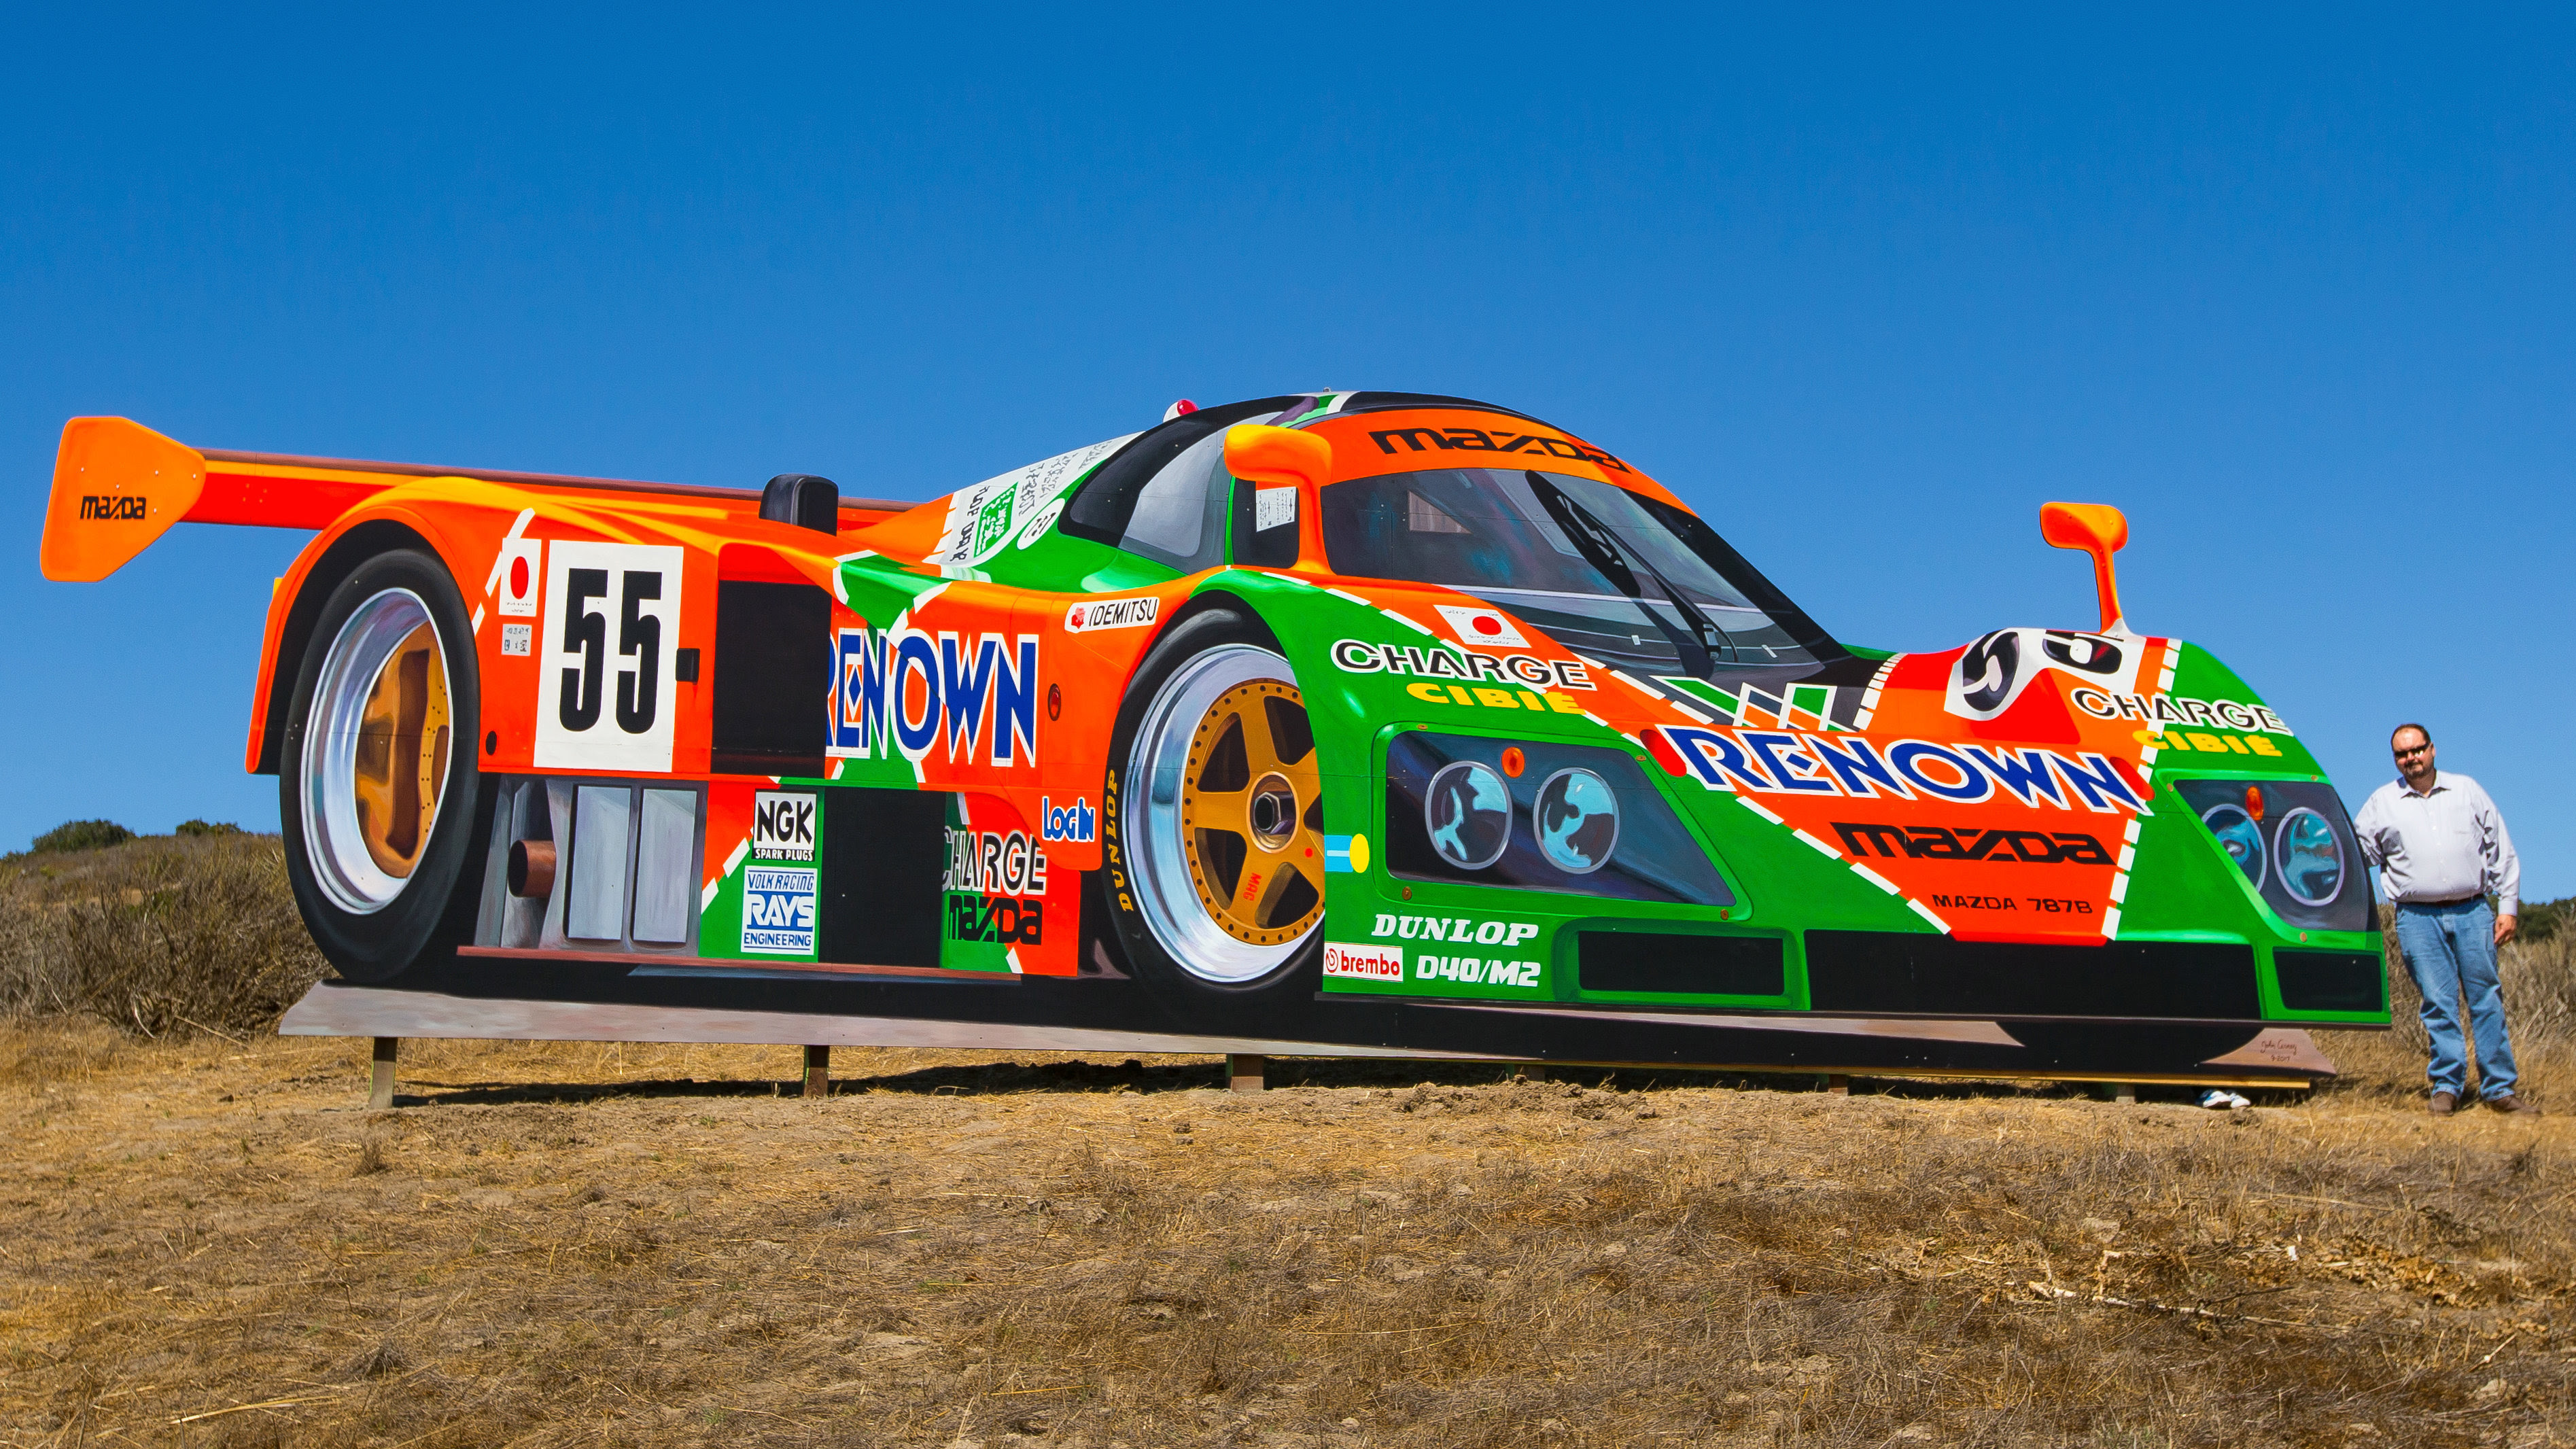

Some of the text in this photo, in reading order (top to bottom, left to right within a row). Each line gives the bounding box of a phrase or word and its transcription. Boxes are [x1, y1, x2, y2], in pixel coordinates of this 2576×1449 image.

[1368, 427, 1632, 474] mazda
[80, 496, 146, 519] mazda
[1089, 599, 1158, 627] IDEMITSU
[559, 568, 663, 735] 55
[1330, 639, 1597, 691] CHARGE
[1406, 682, 1586, 715] CIBIE
[2070, 687, 2295, 737] CHARGE
[2132, 730, 2282, 757] CIBIE
[1654, 724, 2155, 816] RENOWN
[756, 800, 814, 845] NGK
[755, 848, 814, 862] SPARK PLUGS
[1106, 769, 1134, 911] DUNLOP
[1829, 822, 2117, 866] mazda
[748, 873, 814, 891] VOLK RACING
[747, 893, 814, 928] RAYS
[1932, 894, 2093, 913] MAZDA 787B
[744, 932, 812, 947] ENGINEERING
[1370, 913, 1539, 947] DUNLOP
[1341, 949, 1400, 977] brembo
[1415, 954, 1542, 987] D40/M2
